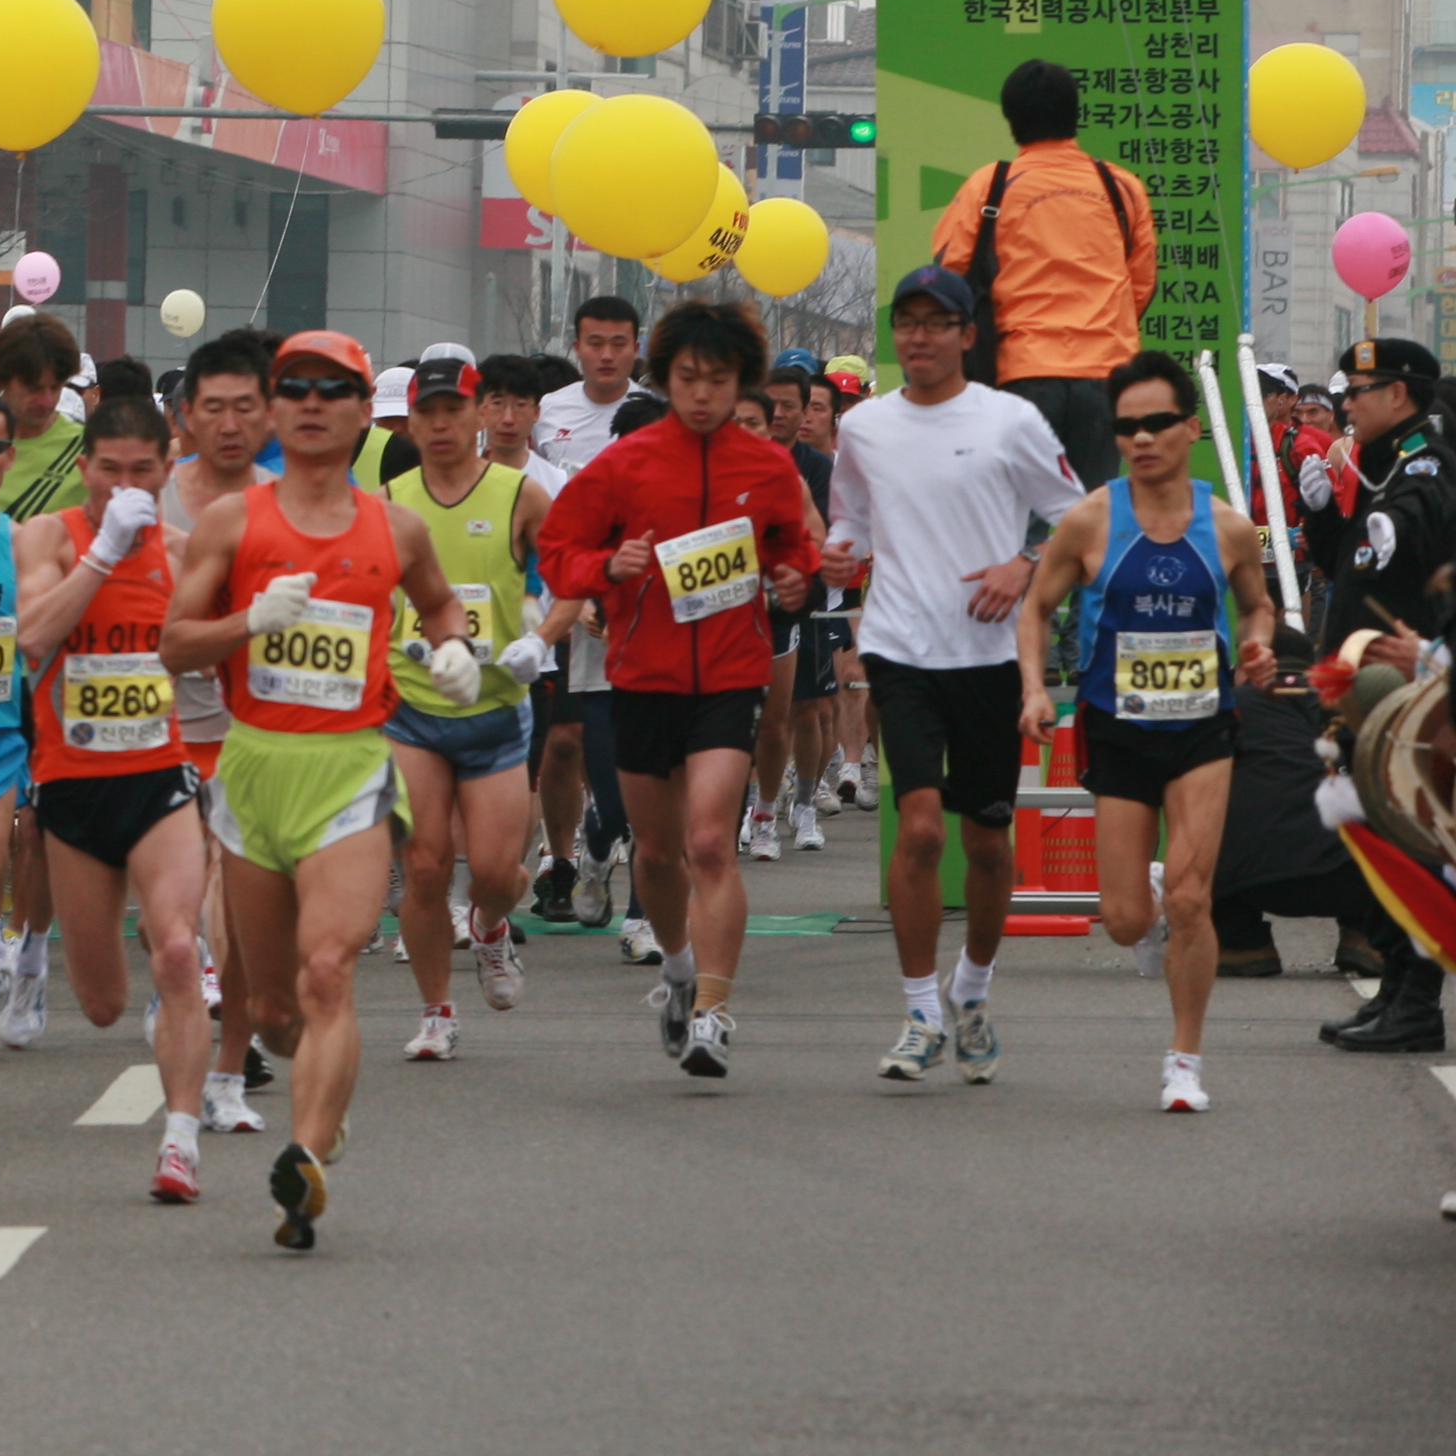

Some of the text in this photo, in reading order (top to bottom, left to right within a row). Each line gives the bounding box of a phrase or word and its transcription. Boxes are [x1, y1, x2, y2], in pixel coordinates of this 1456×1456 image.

[1144, 32, 1219, 59] 삼천리
[1119, 139, 1221, 165] 대한항공
[1136, 174, 1221, 200] 오츠카
[1138, 315, 1220, 341] 데건설
[677, 545, 748, 593] 8204
[1134, 593, 1197, 617] 복사골
[263, 630, 355, 674] 8069
[1130, 658, 1206, 690] 8073
[78, 683, 162, 718] 8260
